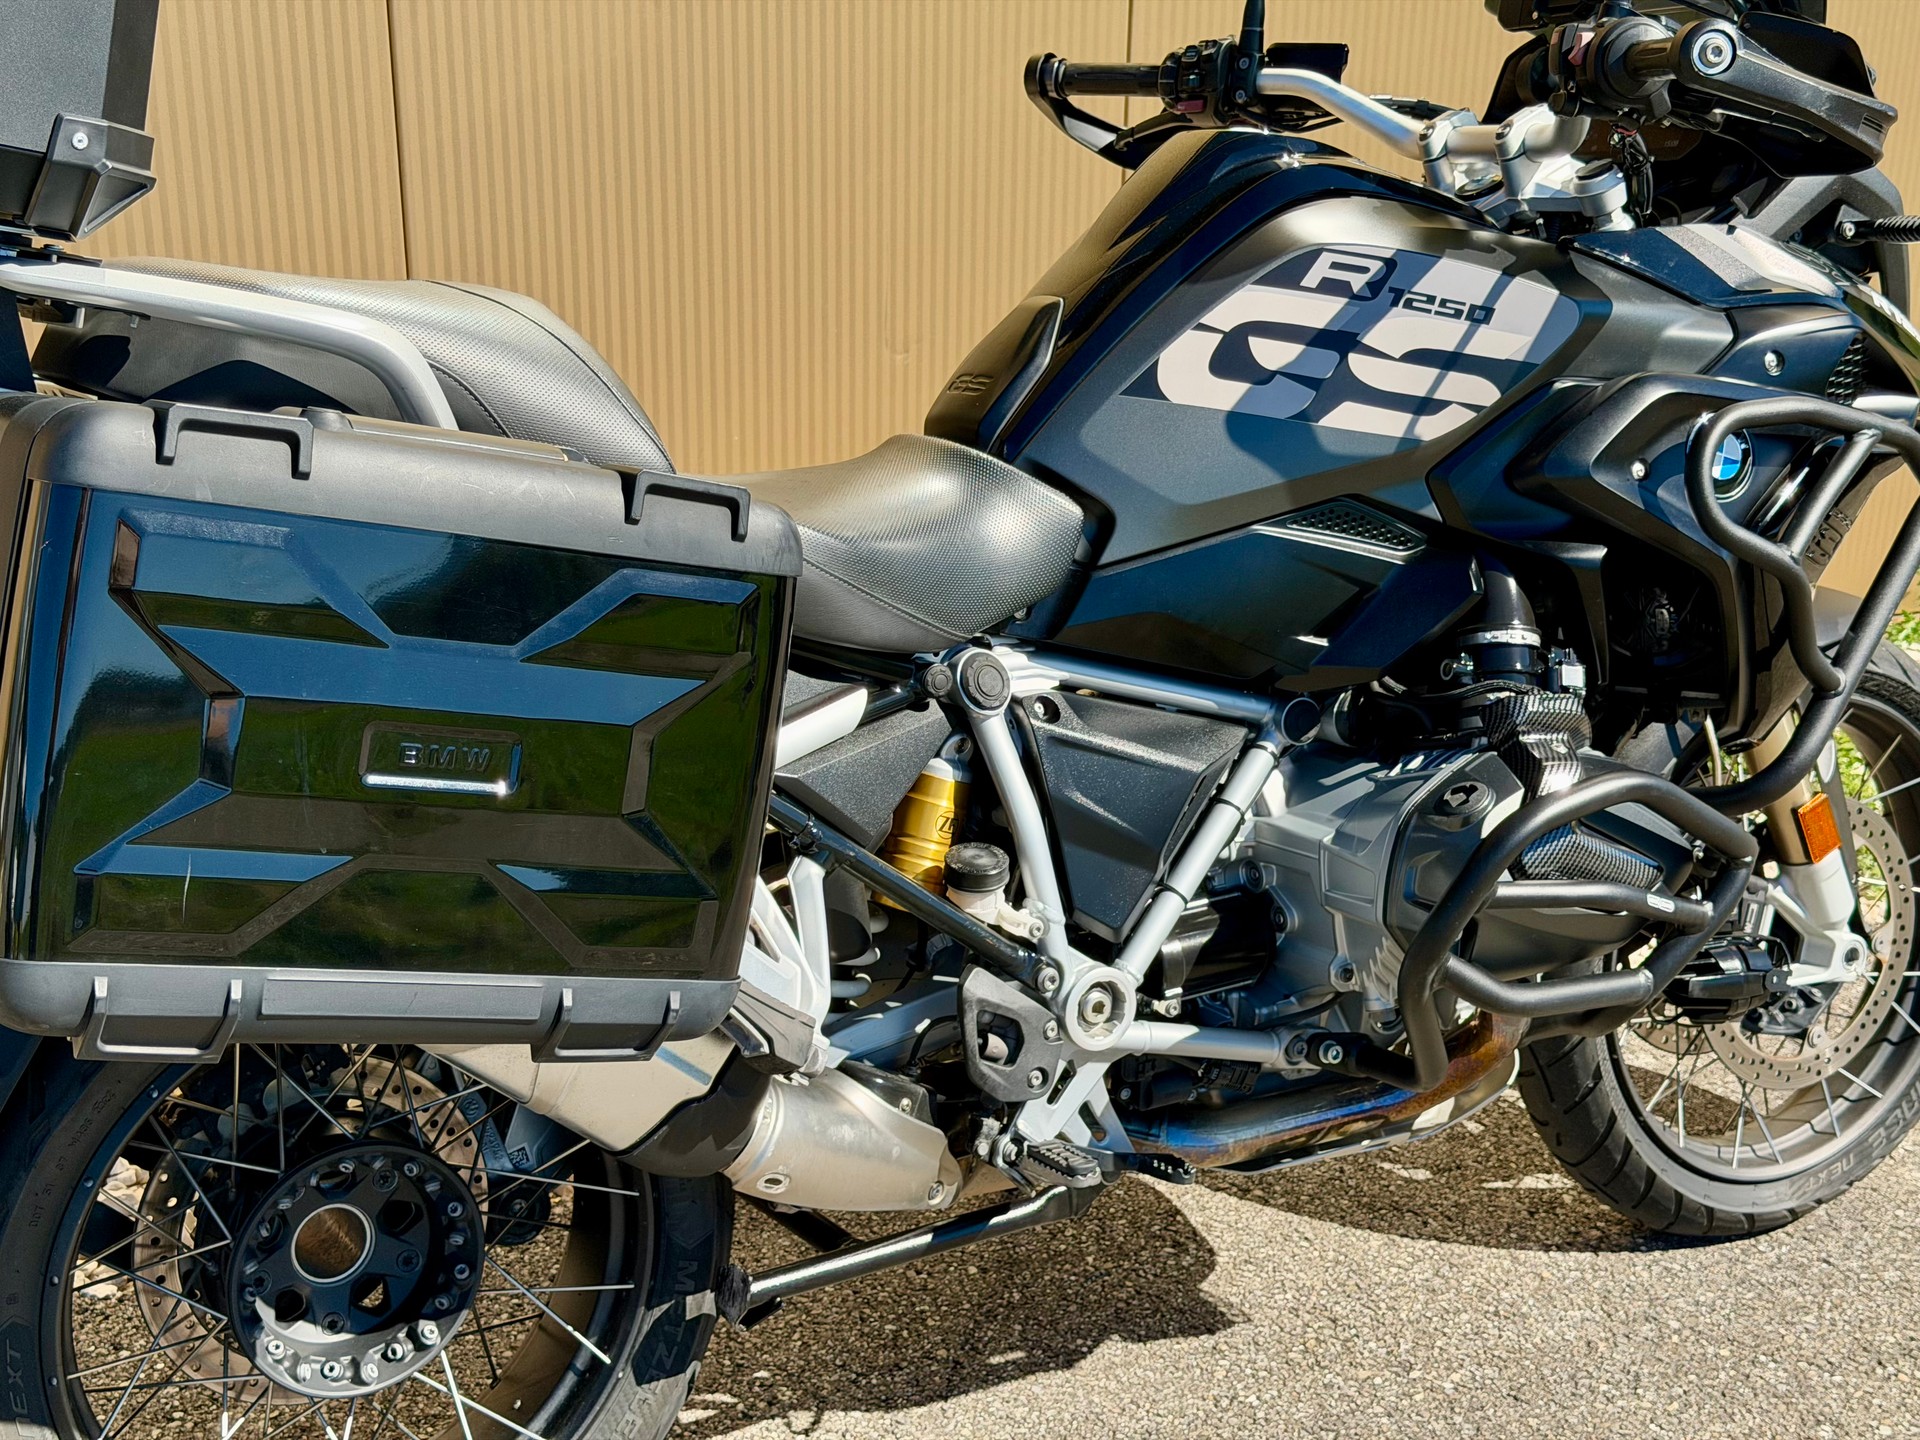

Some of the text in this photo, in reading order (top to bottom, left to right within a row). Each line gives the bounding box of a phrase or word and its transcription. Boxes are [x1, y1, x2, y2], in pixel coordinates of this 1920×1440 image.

[1300, 250, 1496, 326] R 1250
[946, 373, 994, 396] GS
[1157, 284, 1532, 442] GS
[400, 742, 490, 773] BMW
